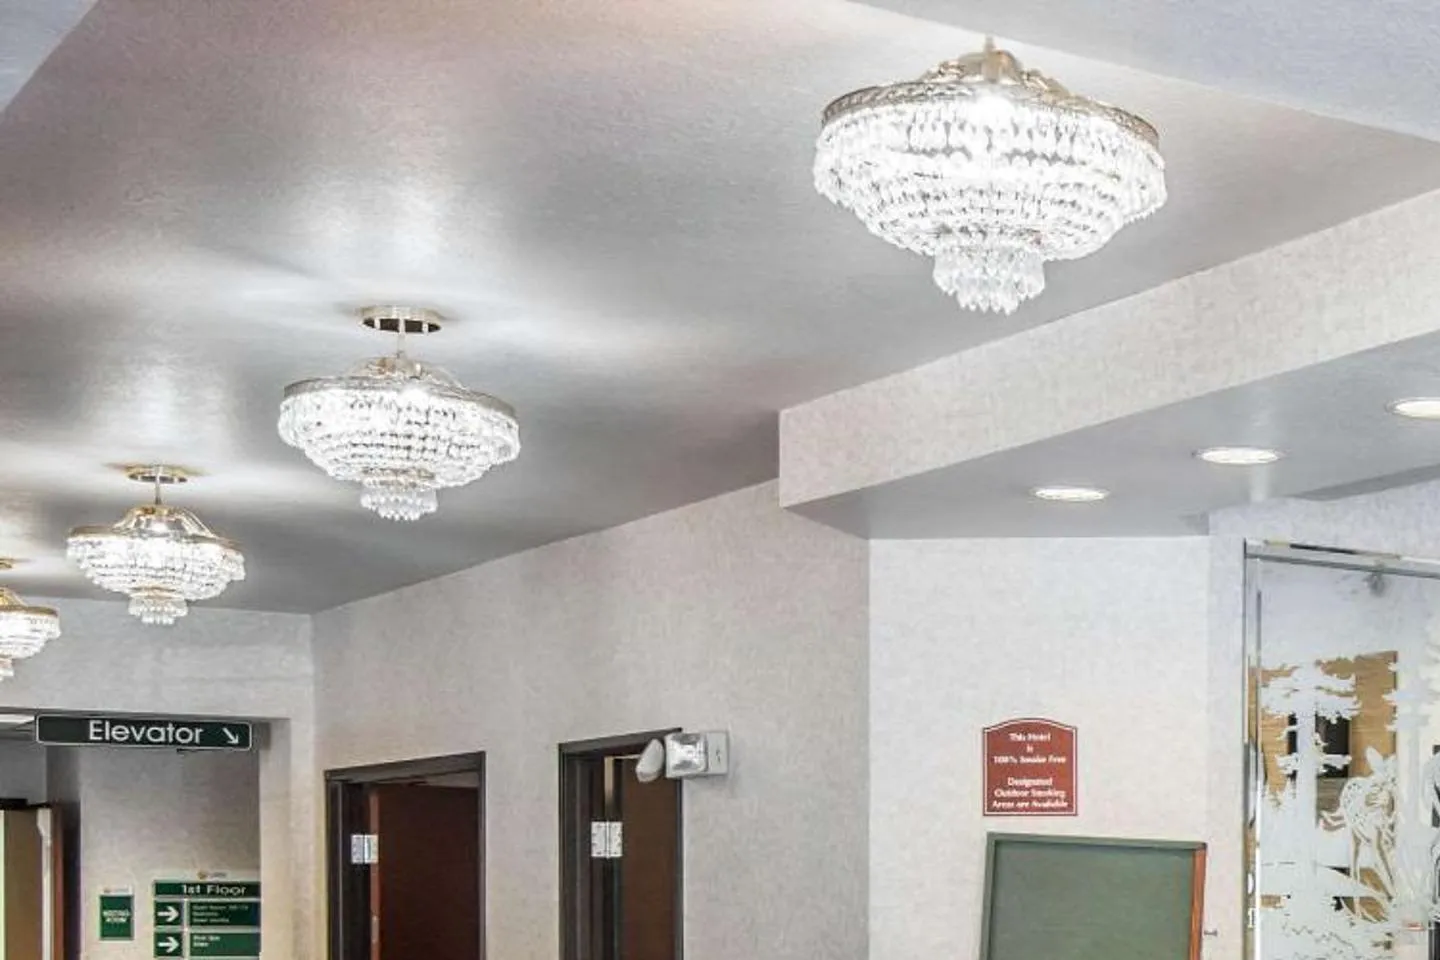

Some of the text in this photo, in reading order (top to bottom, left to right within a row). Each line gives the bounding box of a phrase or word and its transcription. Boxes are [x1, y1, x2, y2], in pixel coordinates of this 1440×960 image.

[88, 719, 203, 744] Elevator
[182, 884, 247, 895] 1st Floor
